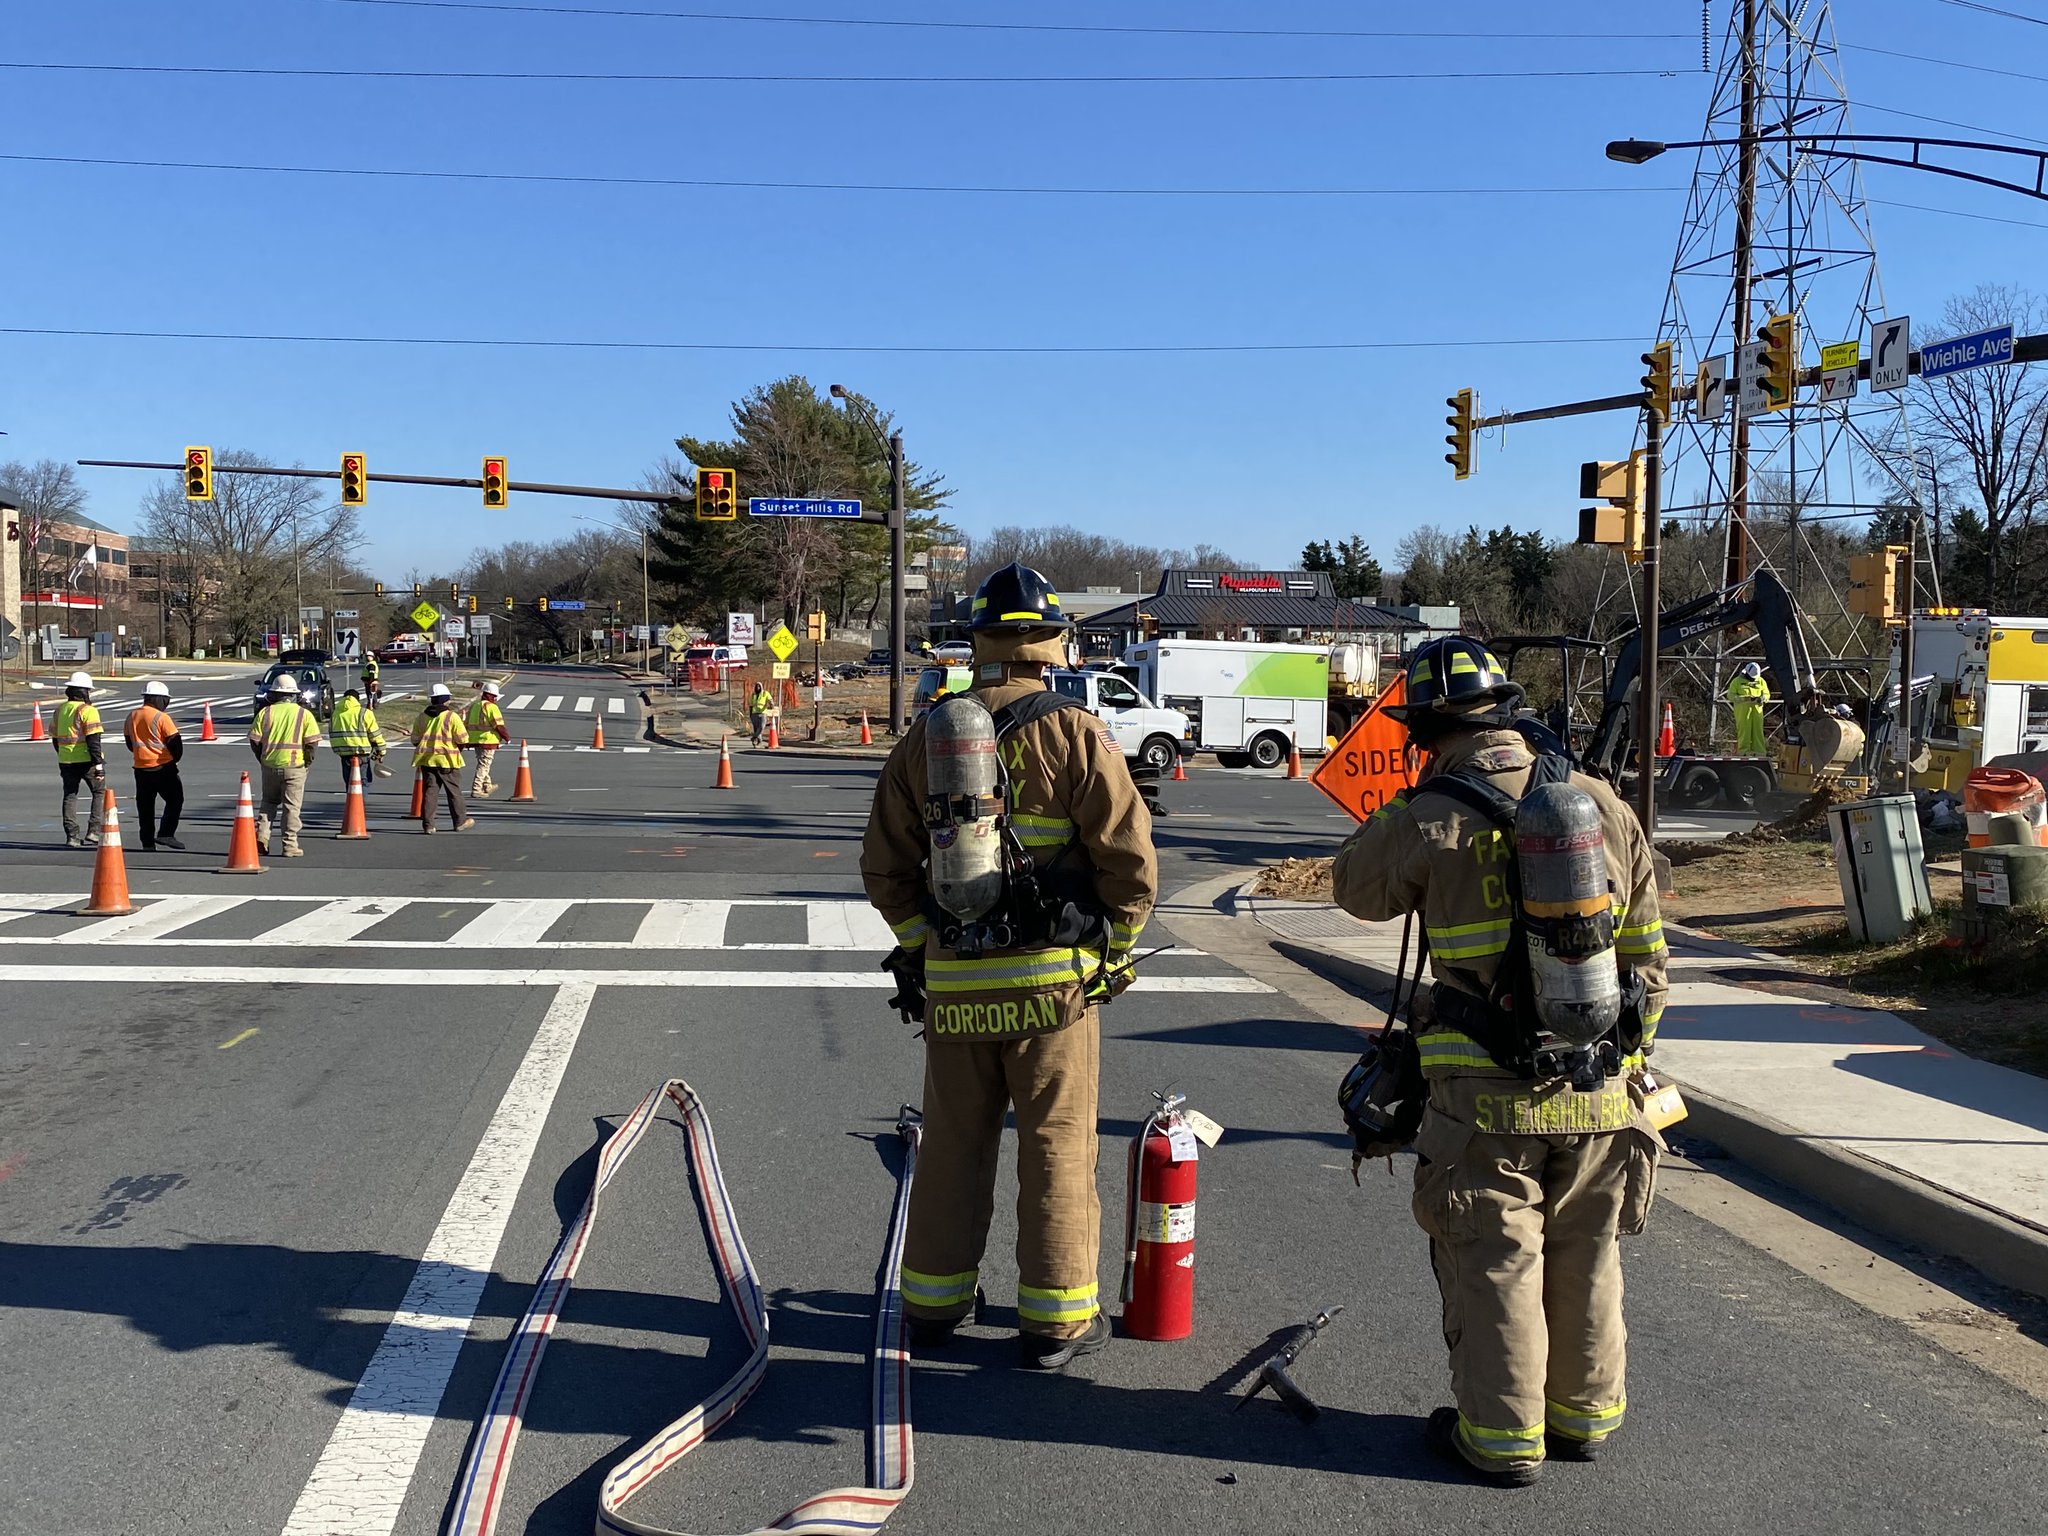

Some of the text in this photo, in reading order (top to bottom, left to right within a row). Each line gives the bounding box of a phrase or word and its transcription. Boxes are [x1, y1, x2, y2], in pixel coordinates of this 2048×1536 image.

[1745, 349, 1752, 358] NO
[1826, 347, 1847, 357] TURNING
[1923, 337, 2011, 371] Wiehle Ave
[1746, 363, 1753, 371] ON
[1826, 358, 1847, 368] VEHICLES
[1875, 368, 1903, 385] ONLY
[1838, 380, 1845, 388] TO
[1741, 401, 1767, 413] RIGHT LAN
[759, 502, 853, 513] Sunset Hills Rd
[1220, 576, 1281, 592] Pupatella
[1680, 616, 1721, 638] DEERE
[1345, 748, 1431, 777] SIDEW
[1572, 832, 1600, 846] SCOTT
[934, 995, 1058, 1034] CORCORAN
